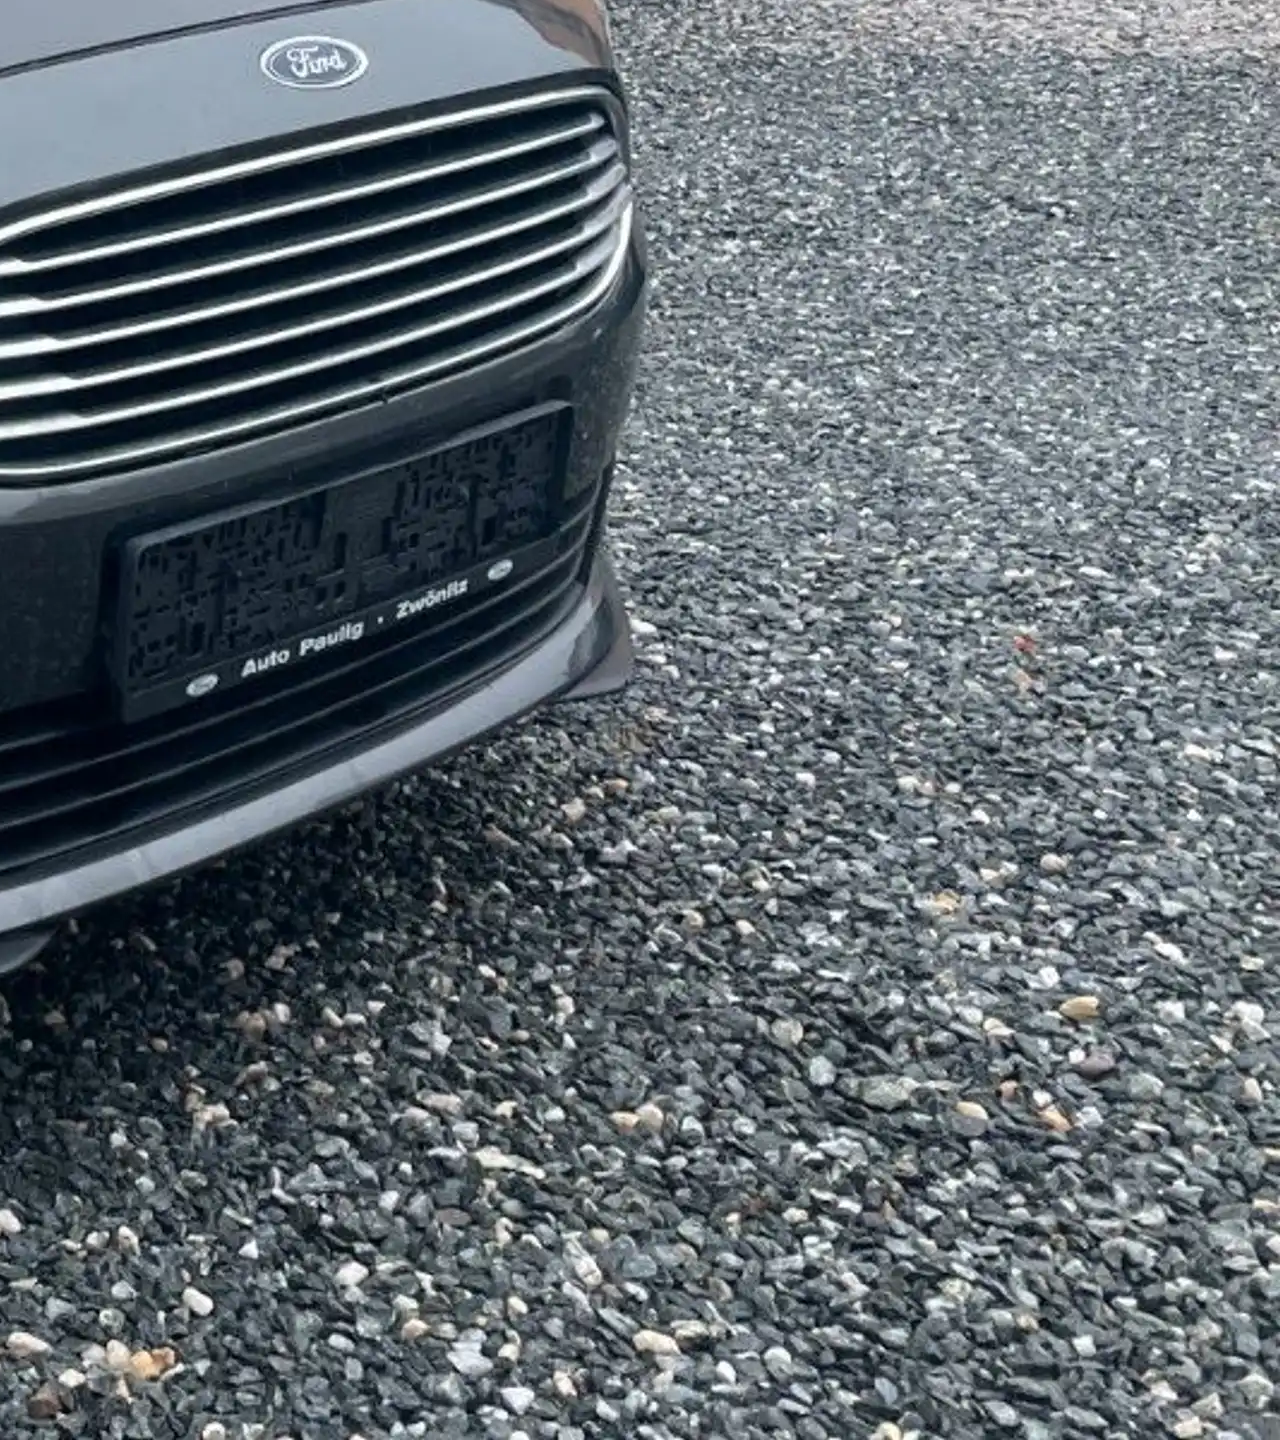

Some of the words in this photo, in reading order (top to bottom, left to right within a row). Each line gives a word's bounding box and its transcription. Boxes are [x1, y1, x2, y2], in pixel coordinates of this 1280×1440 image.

[286, 45, 348, 78] Ford
[240, 649, 291, 678] Auto
[299, 621, 365, 657] Paulig
